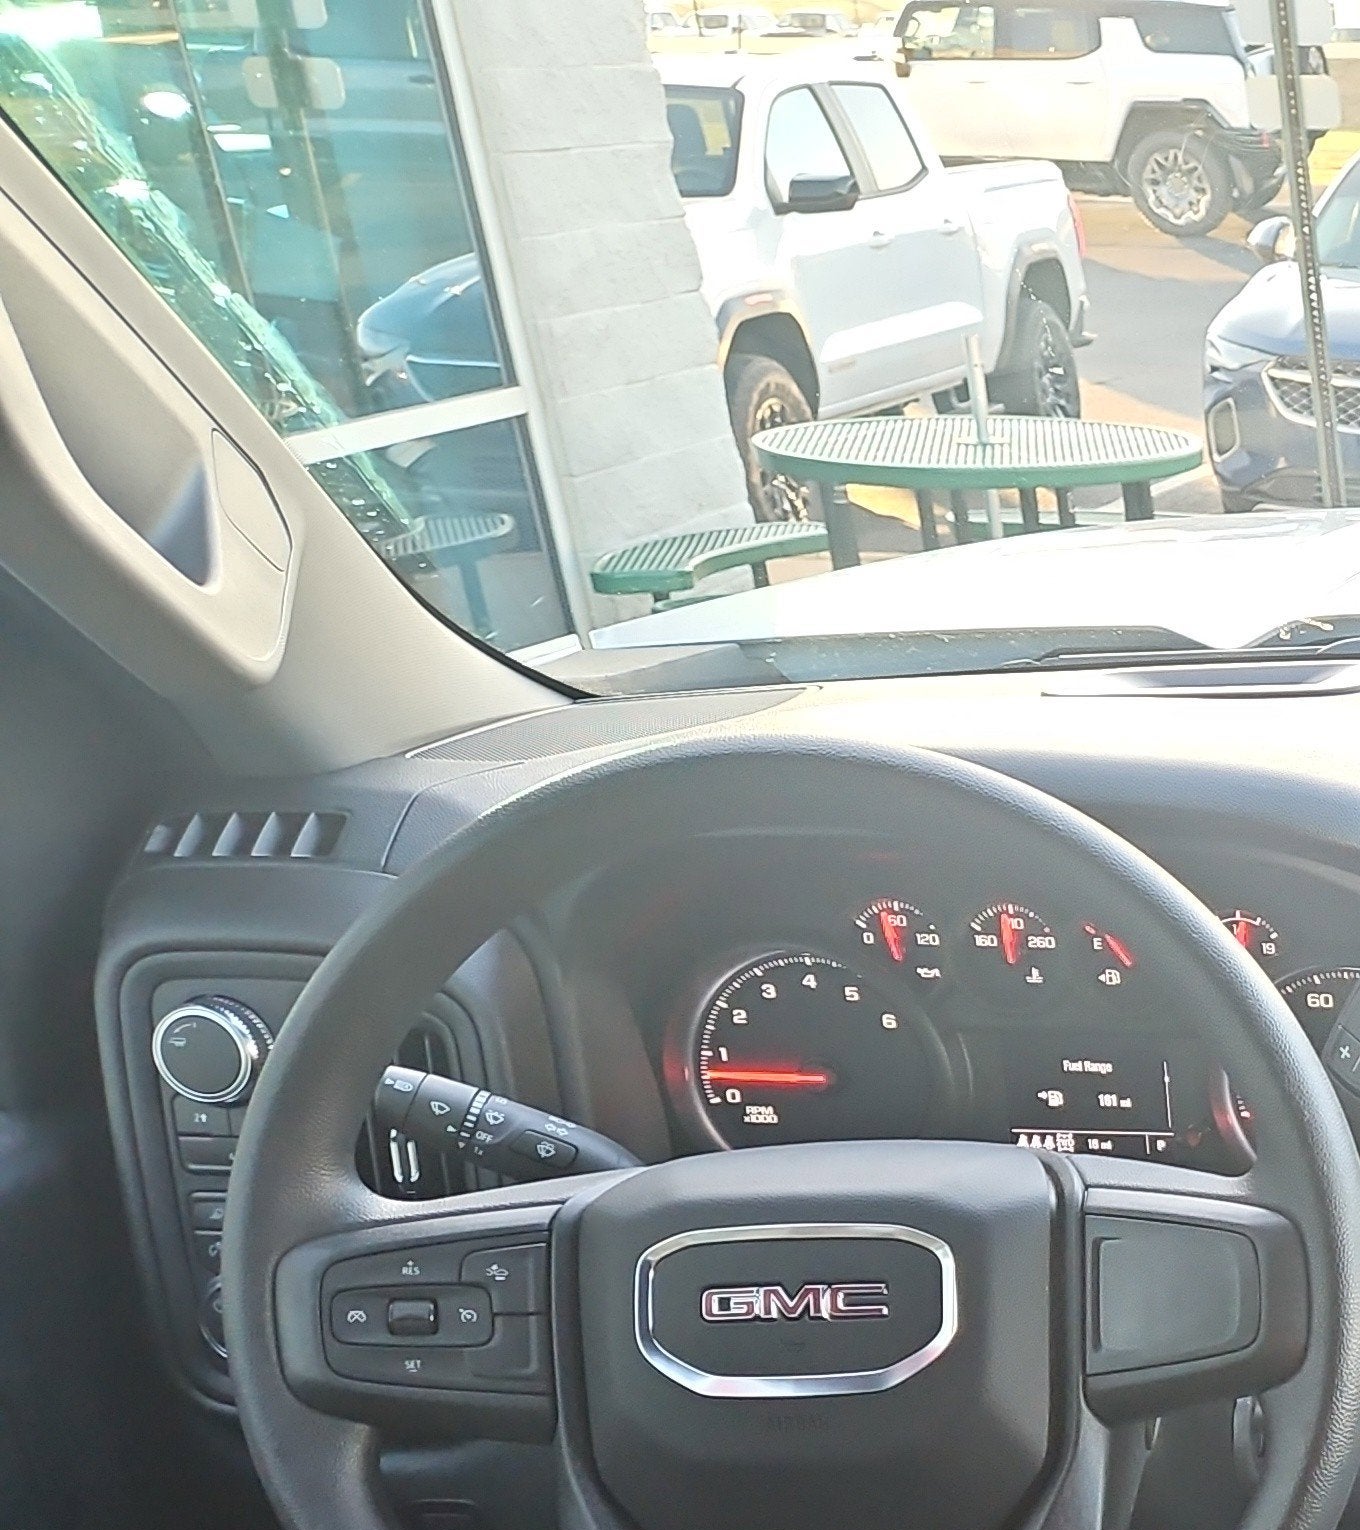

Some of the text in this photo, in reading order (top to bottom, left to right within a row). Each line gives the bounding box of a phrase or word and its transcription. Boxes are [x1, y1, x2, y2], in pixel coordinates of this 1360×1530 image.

[862, 932, 874, 945] 0
[916, 933, 940, 945] 120
[974, 935, 998, 947] 160
[1027, 936, 1055, 949] 260
[1093, 937, 1103, 950] E
[1261, 942, 1276, 955] 19
[801, 974, 817, 989] 4
[761, 983, 777, 999] 3
[844, 986, 860, 1001] 5
[1306, 993, 1334, 1008] 60
[732, 1008, 748, 1024] 2
[881, 1013, 898, 1029] 6
[718, 1046, 729, 1062] 1
[1062, 1060, 1113, 1074] Fuel Range
[726, 1088, 742, 1103] 0
[745, 1105, 774, 1115] RPM
[476, 1130, 494, 1144] OFF
[1156, 1139, 1166, 1151] P
[702, 1283, 889, 1322] GMC
